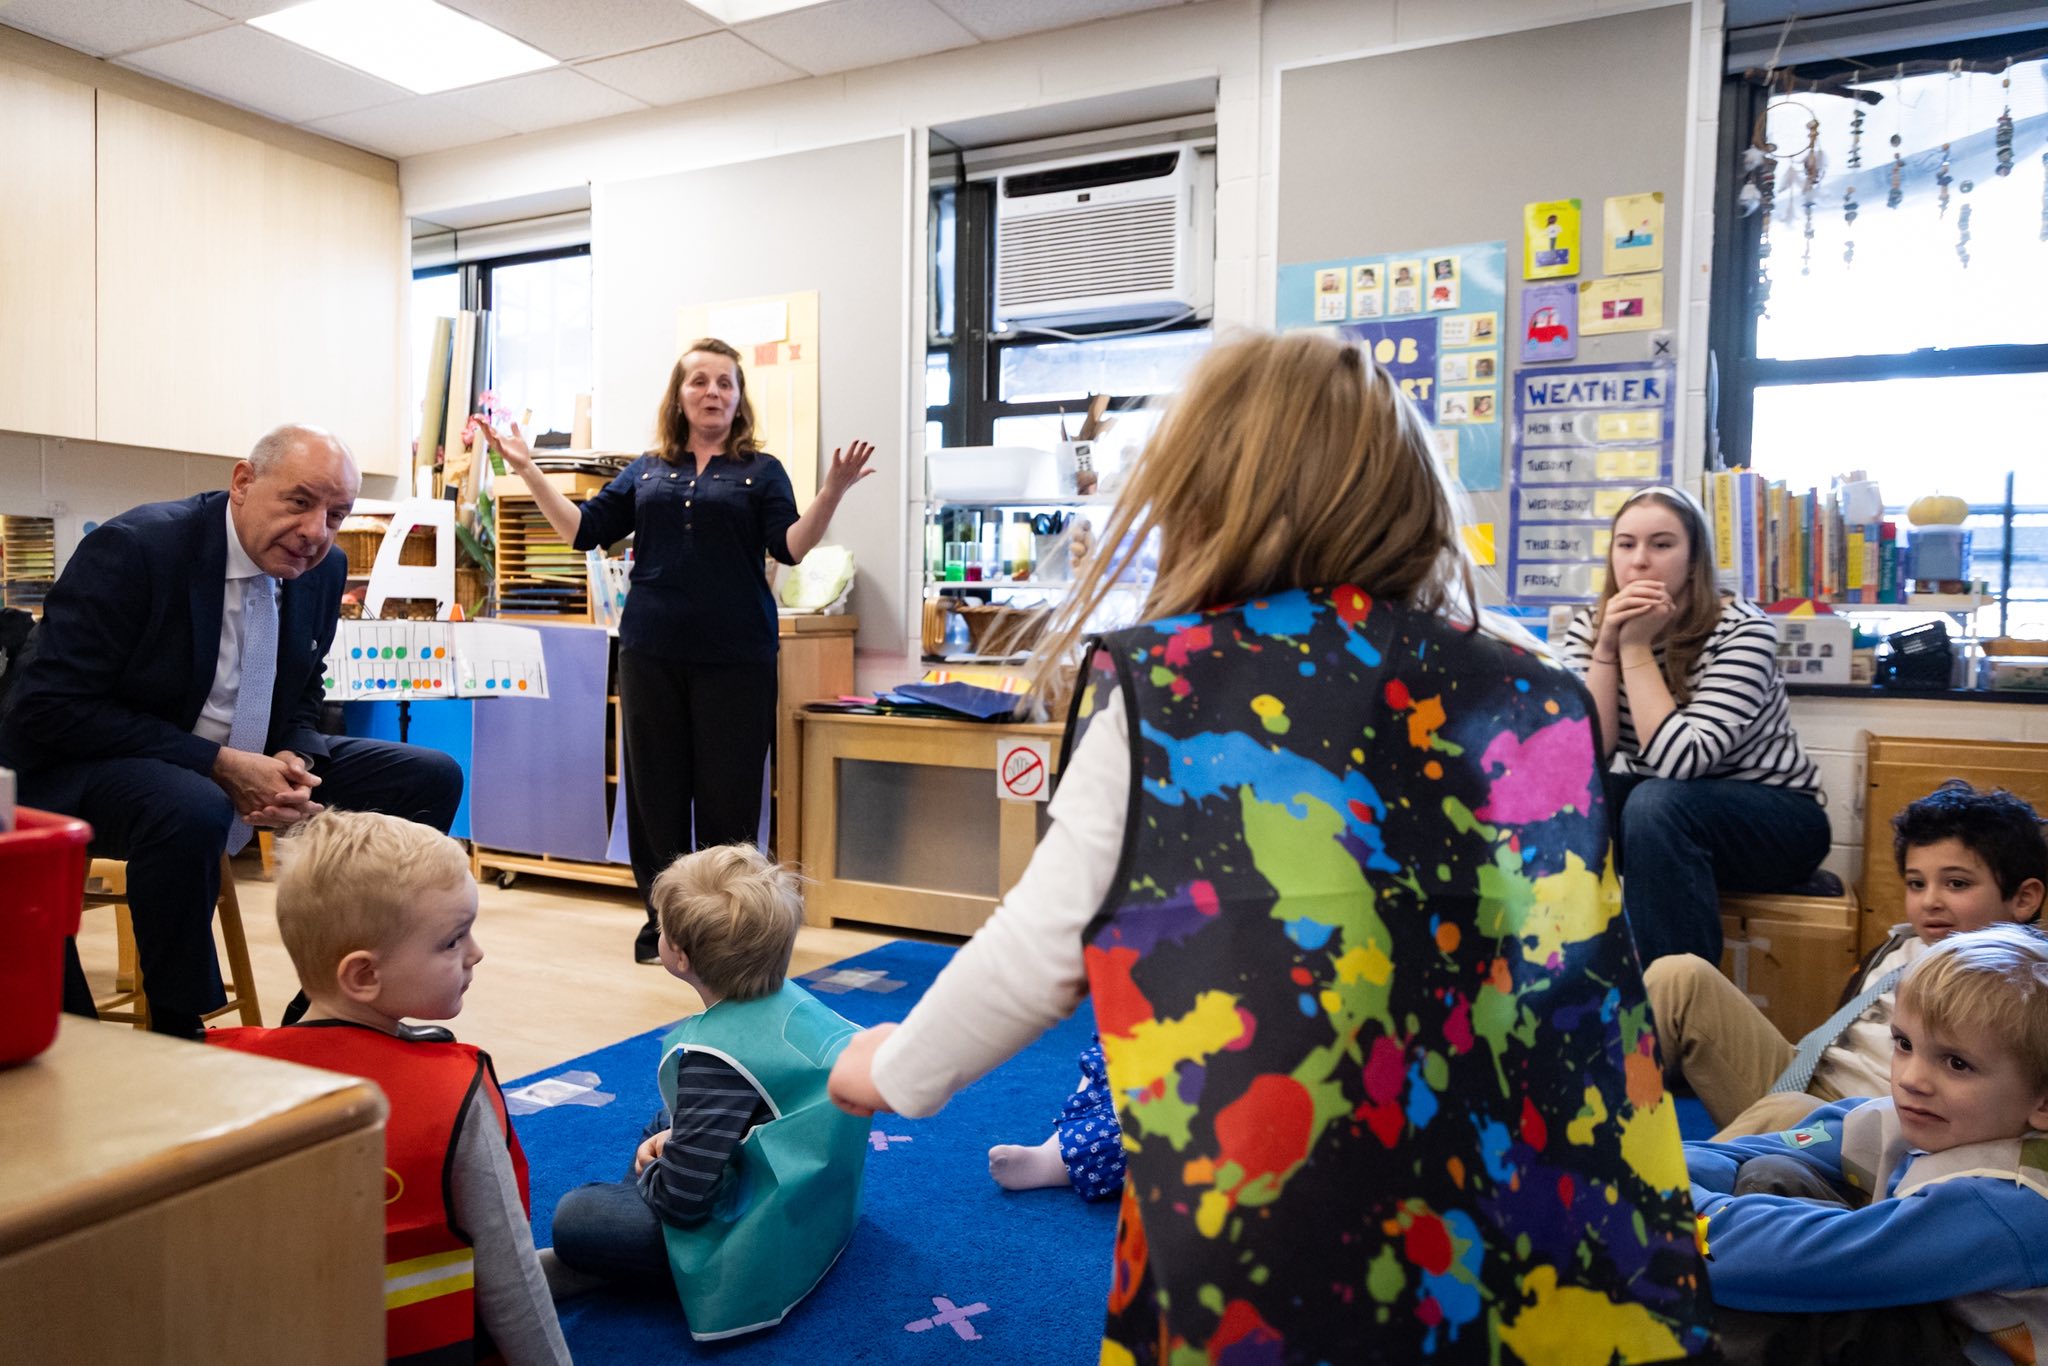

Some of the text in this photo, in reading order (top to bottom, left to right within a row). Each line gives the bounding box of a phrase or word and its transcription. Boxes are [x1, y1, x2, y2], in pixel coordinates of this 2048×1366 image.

[1364, 337, 1419, 364] OB
[1400, 377, 1434, 400] RT
[1528, 378, 1660, 406] WEATHER
[1527, 421, 1573, 434] MONAY
[1523, 575, 1562, 587] FRIDAY
